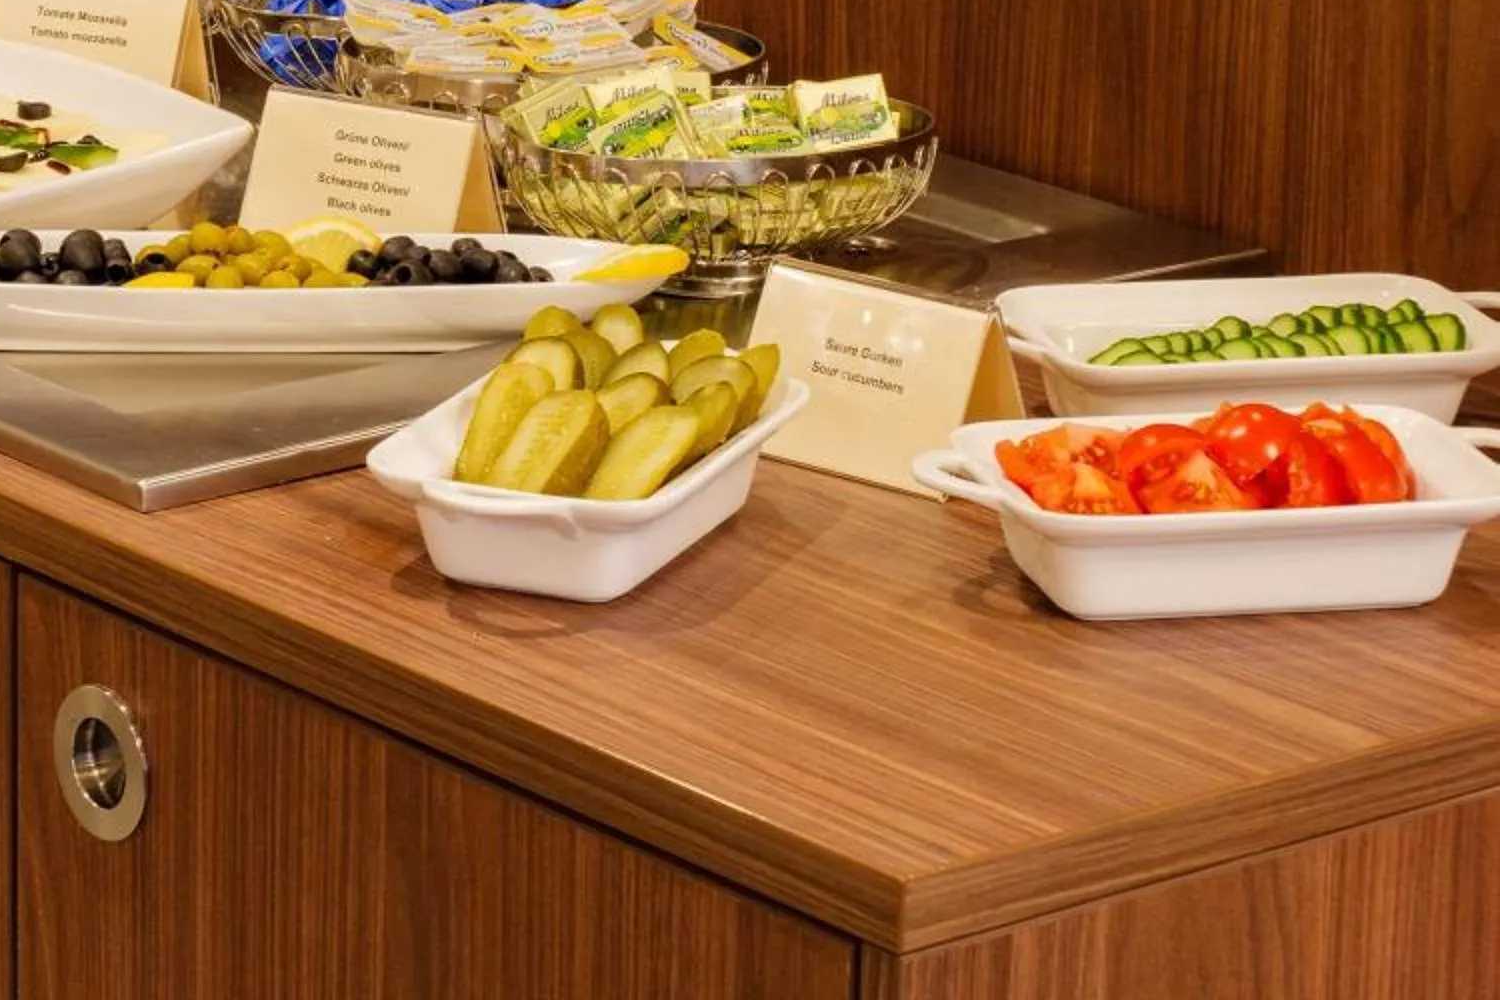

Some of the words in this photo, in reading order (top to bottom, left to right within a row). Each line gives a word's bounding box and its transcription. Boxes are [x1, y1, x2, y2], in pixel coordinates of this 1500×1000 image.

[333, 152, 367, 166] Green
[369, 160, 401, 173] olives
[327, 196, 357, 211] Black
[359, 203, 391, 217] olives
[811, 359, 839, 377] Sour
[841, 371, 905, 394] cucumbers
